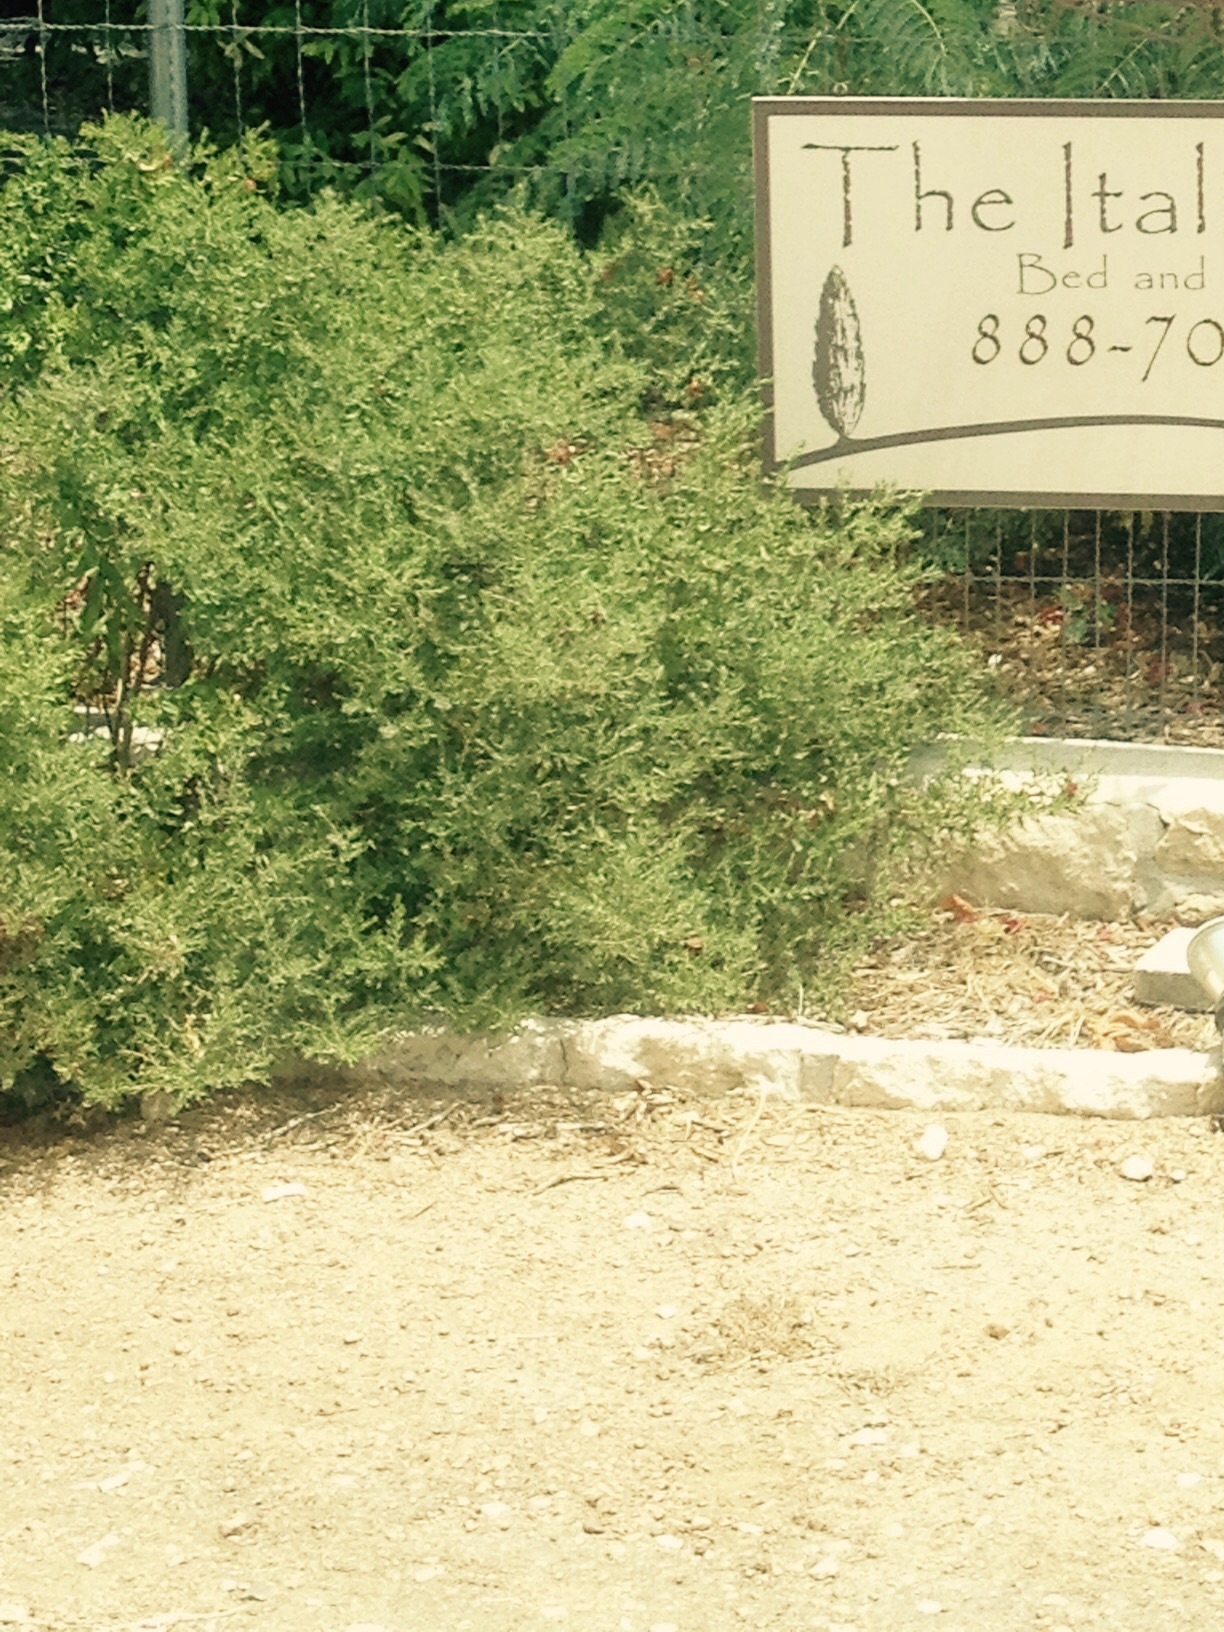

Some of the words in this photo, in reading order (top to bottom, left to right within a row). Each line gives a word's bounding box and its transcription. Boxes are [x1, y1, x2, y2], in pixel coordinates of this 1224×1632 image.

[801, 139, 1016, 249] The
[1016, 253, 1108, 296] Bed
[1134, 255, 1206, 293] and
